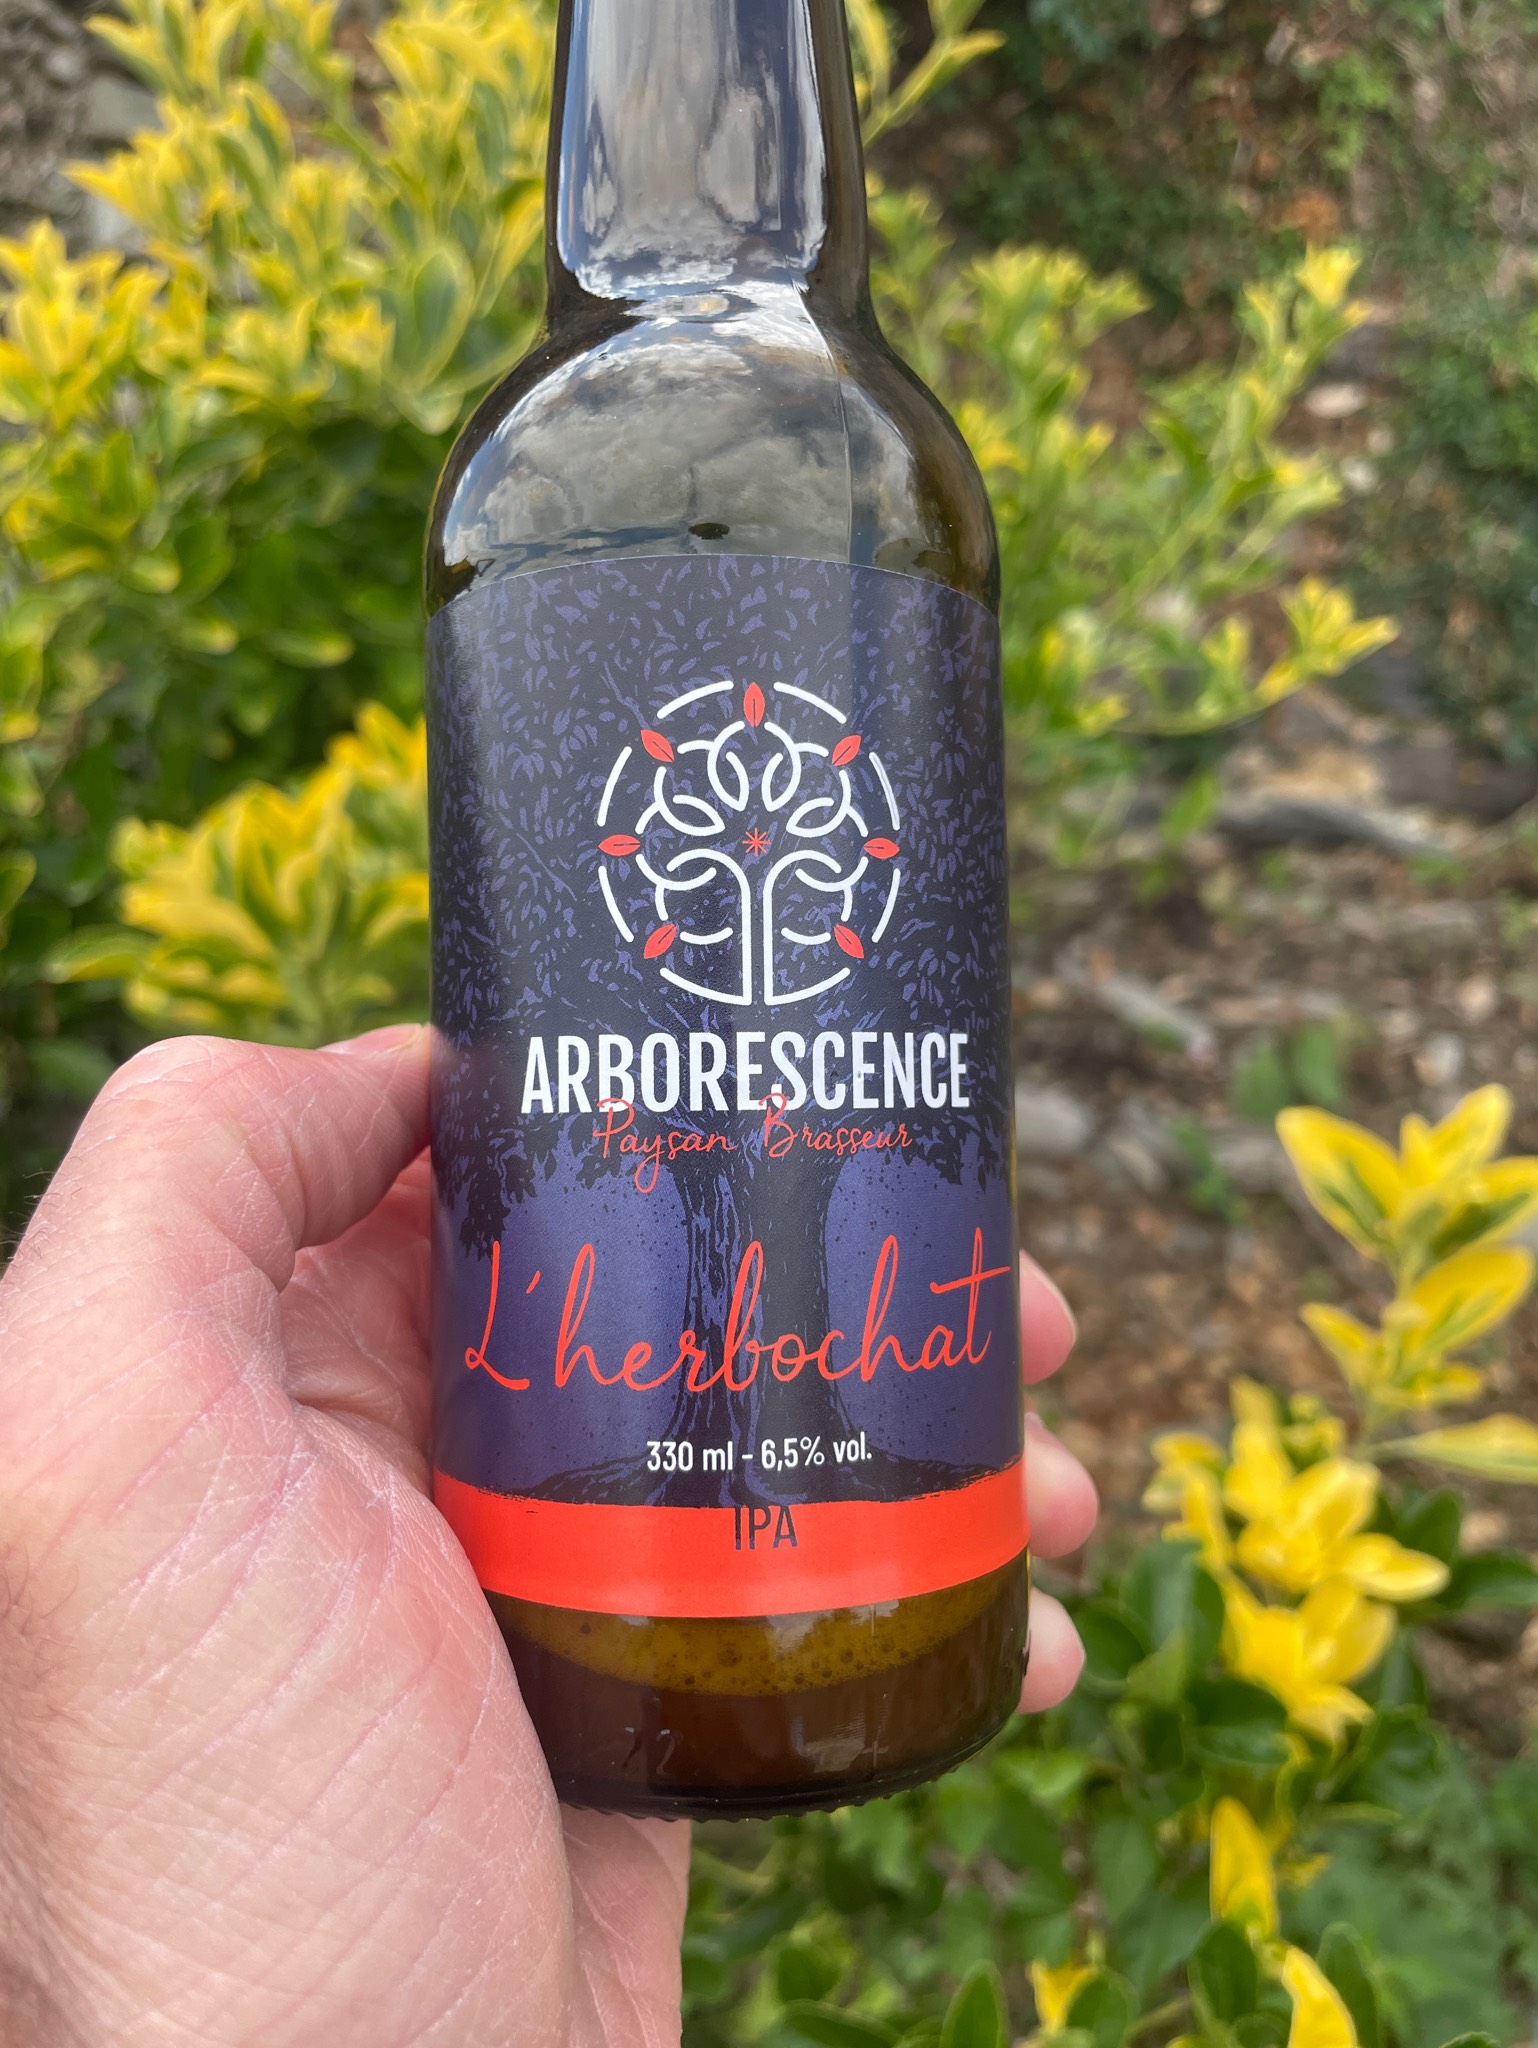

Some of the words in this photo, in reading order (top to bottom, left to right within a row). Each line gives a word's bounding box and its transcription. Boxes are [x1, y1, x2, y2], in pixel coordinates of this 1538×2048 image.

[521, 1030, 970, 1114] ARBORESCENCE
[592, 1097, 734, 1193] Paysan
[757, 1092, 914, 1159] Brasseur
[465, 1227, 1011, 1393] L'herbochat
[646, 1440, 694, 1472] 330
[702, 1440, 734, 1471] ml
[761, 1435, 825, 1472] 6,5%
[832, 1431, 873, 1463] vol.
[735, 1504, 798, 1550] IPA
